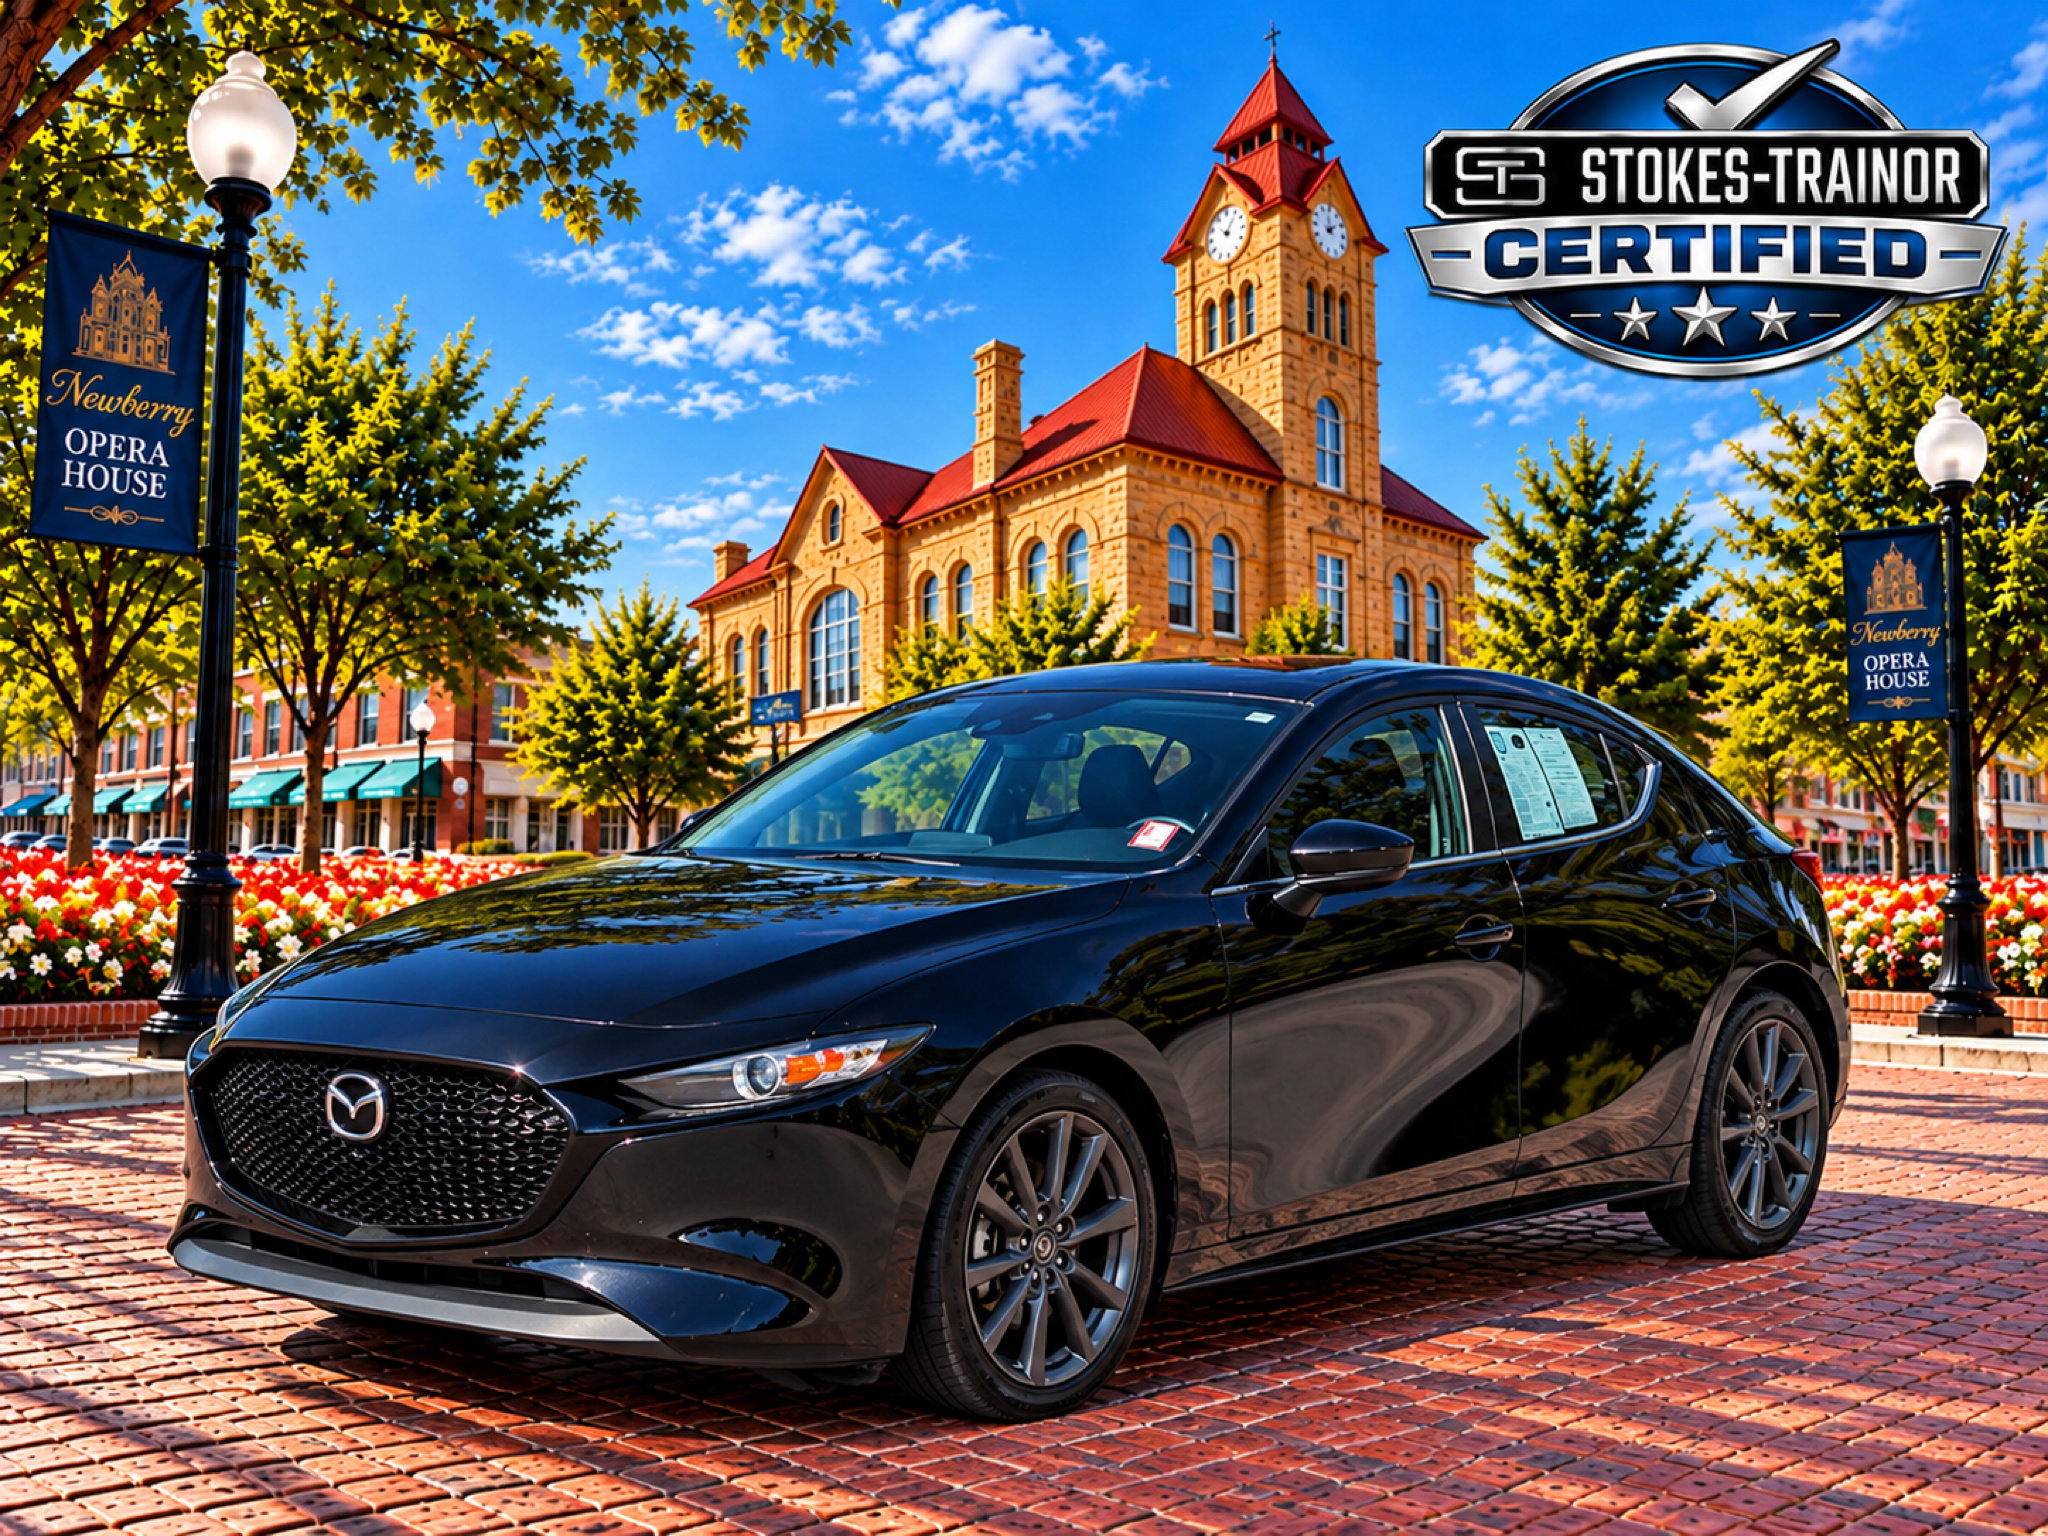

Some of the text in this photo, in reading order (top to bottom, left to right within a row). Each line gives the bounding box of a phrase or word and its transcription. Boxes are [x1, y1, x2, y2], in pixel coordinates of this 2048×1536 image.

[46, 368, 195, 438] Newberry
[64, 427, 170, 468] OPERA
[61, 459, 168, 500] HOUSE
[1850, 618, 1941, 647] Newberry
[1863, 651, 1930, 672] OPERA
[1865, 669, 1930, 690] HOUSE
